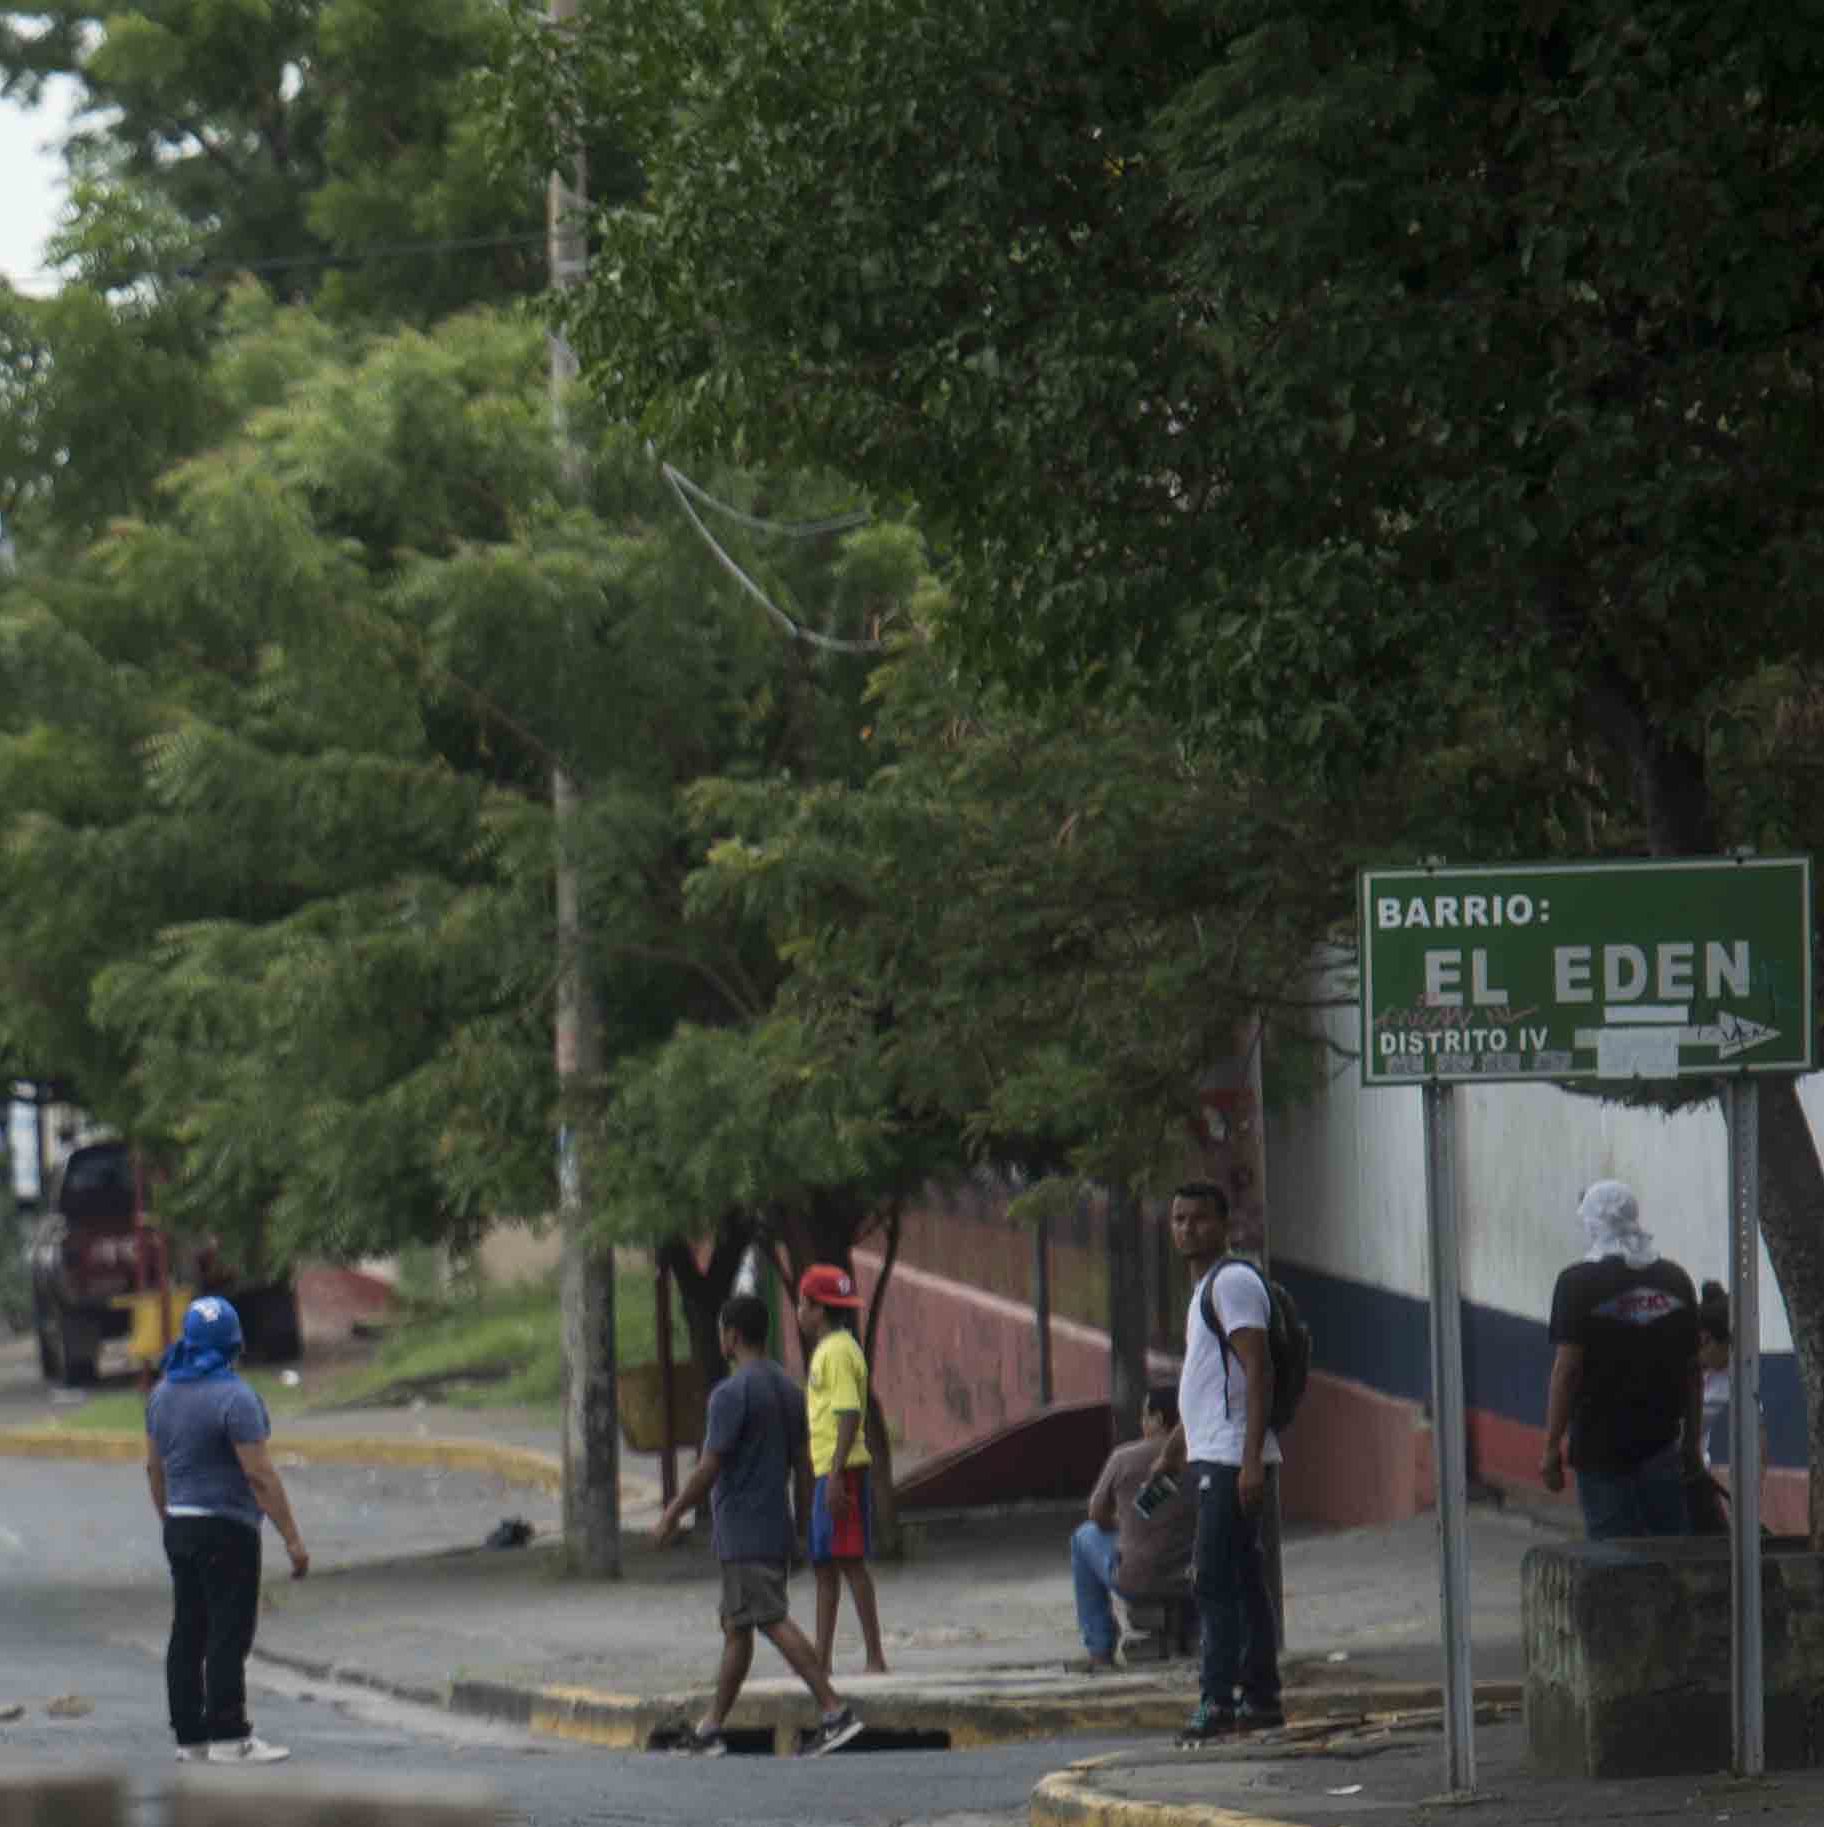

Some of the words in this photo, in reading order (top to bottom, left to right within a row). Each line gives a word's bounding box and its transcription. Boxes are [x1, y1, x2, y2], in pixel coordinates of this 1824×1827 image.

[1377, 894, 1550, 929] BARRIO:
[1424, 948, 1508, 1008] EL
[1553, 940, 1750, 1004] EDEN
[1380, 1027, 1507, 1056] DISTRITO
[1519, 1025, 1549, 1051] IV
